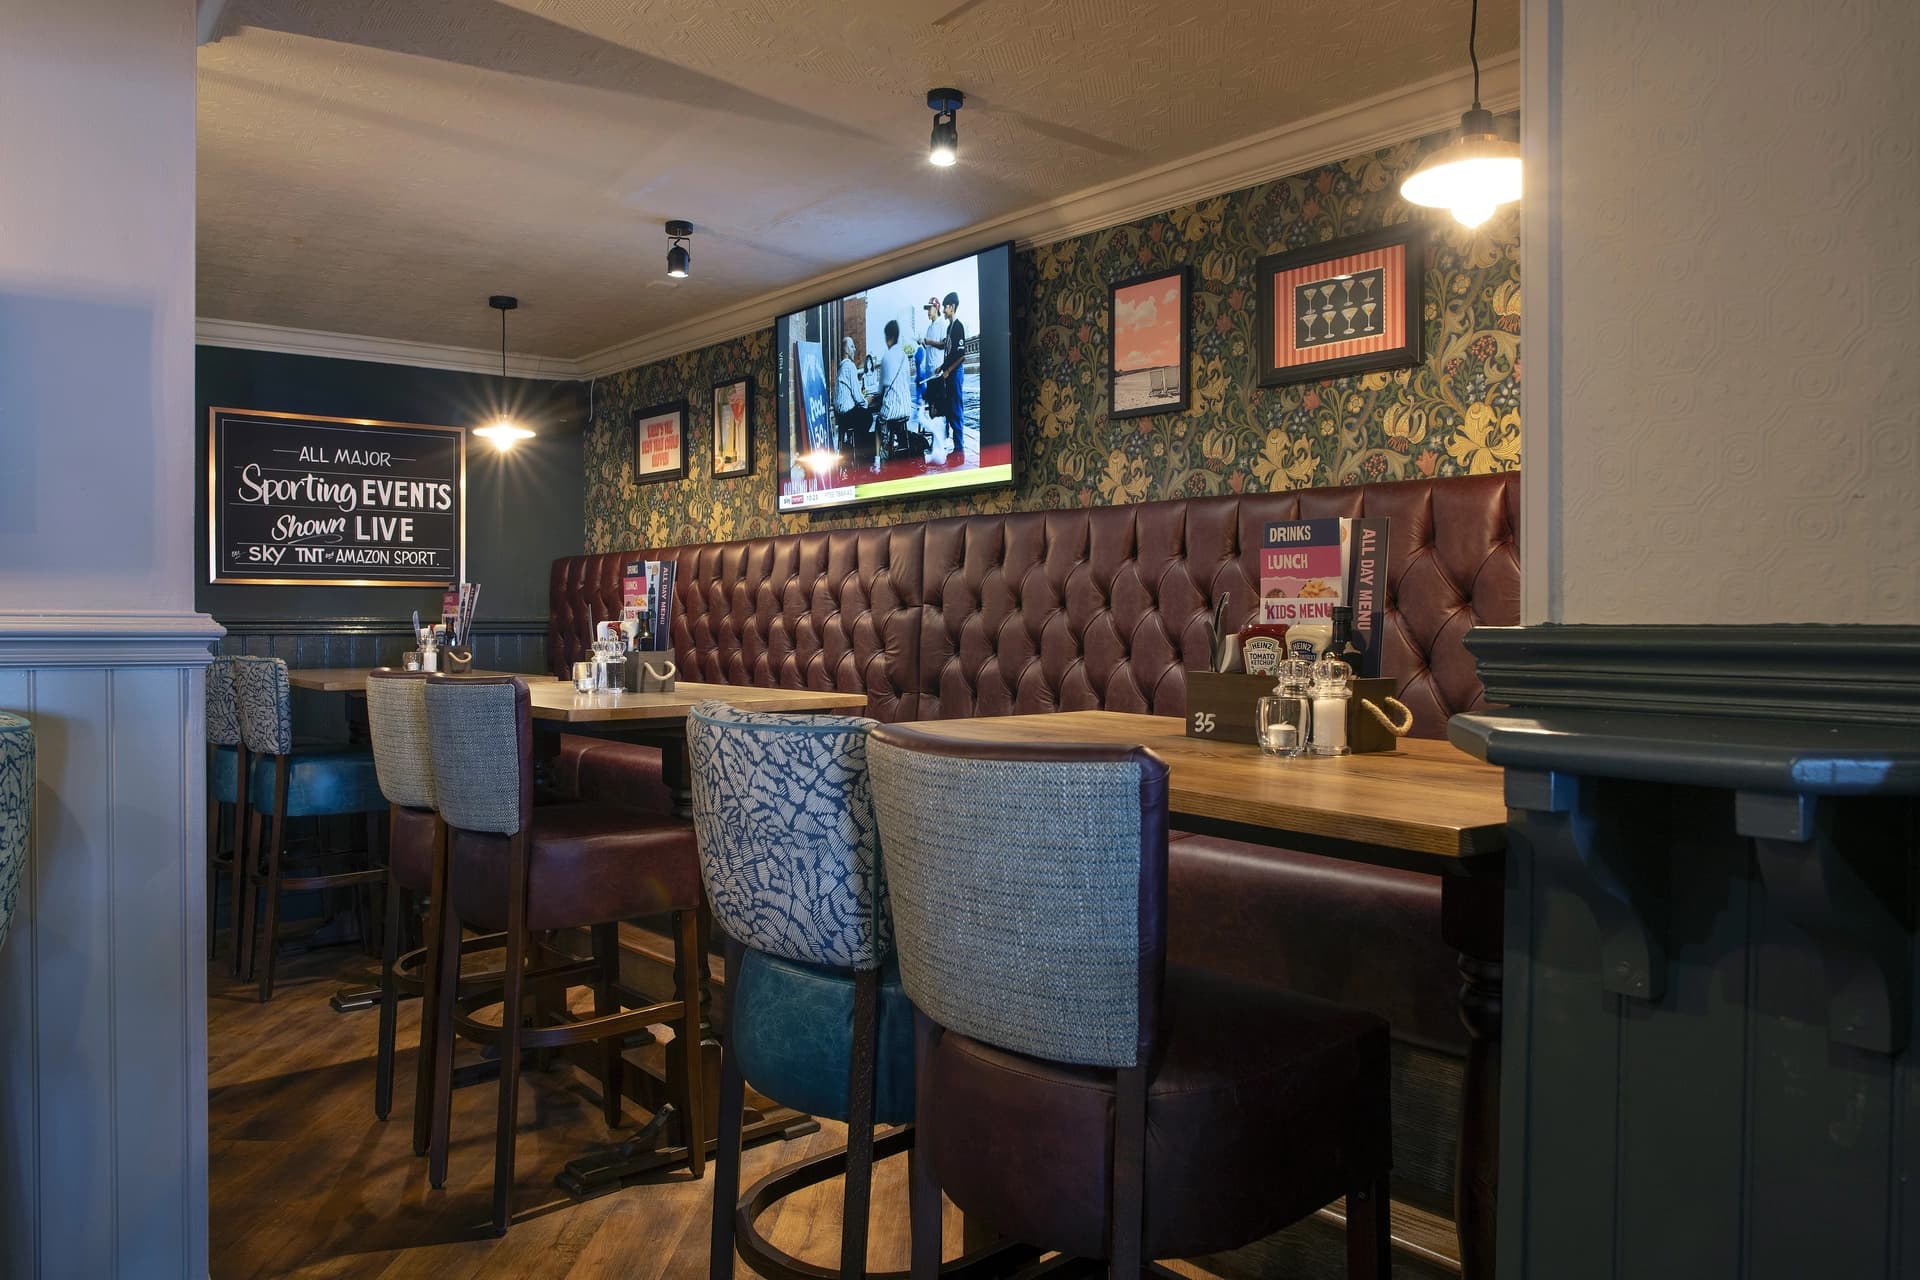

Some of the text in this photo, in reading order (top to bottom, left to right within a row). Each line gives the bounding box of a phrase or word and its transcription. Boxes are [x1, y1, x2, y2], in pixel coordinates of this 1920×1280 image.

[299, 446, 392, 467] ALL MAJOR
[238, 463, 451, 513] Sporting EVENTS
[271, 514, 414, 542] Shown LIVE
[1269, 525, 1311, 543] DRINKS
[295, 547, 325, 563] TNT
[335, 548, 390, 565] AMAZON
[1267, 553, 1308, 570] LUNCH
[1357, 528, 1377, 631] ALL DAY MENU
[1266, 602, 1335, 620] KIDS MENU
[1251, 642, 1273, 650] HEINZ
[1292, 641, 1312, 652] HEINZ
[1194, 711, 1216, 733] 35
